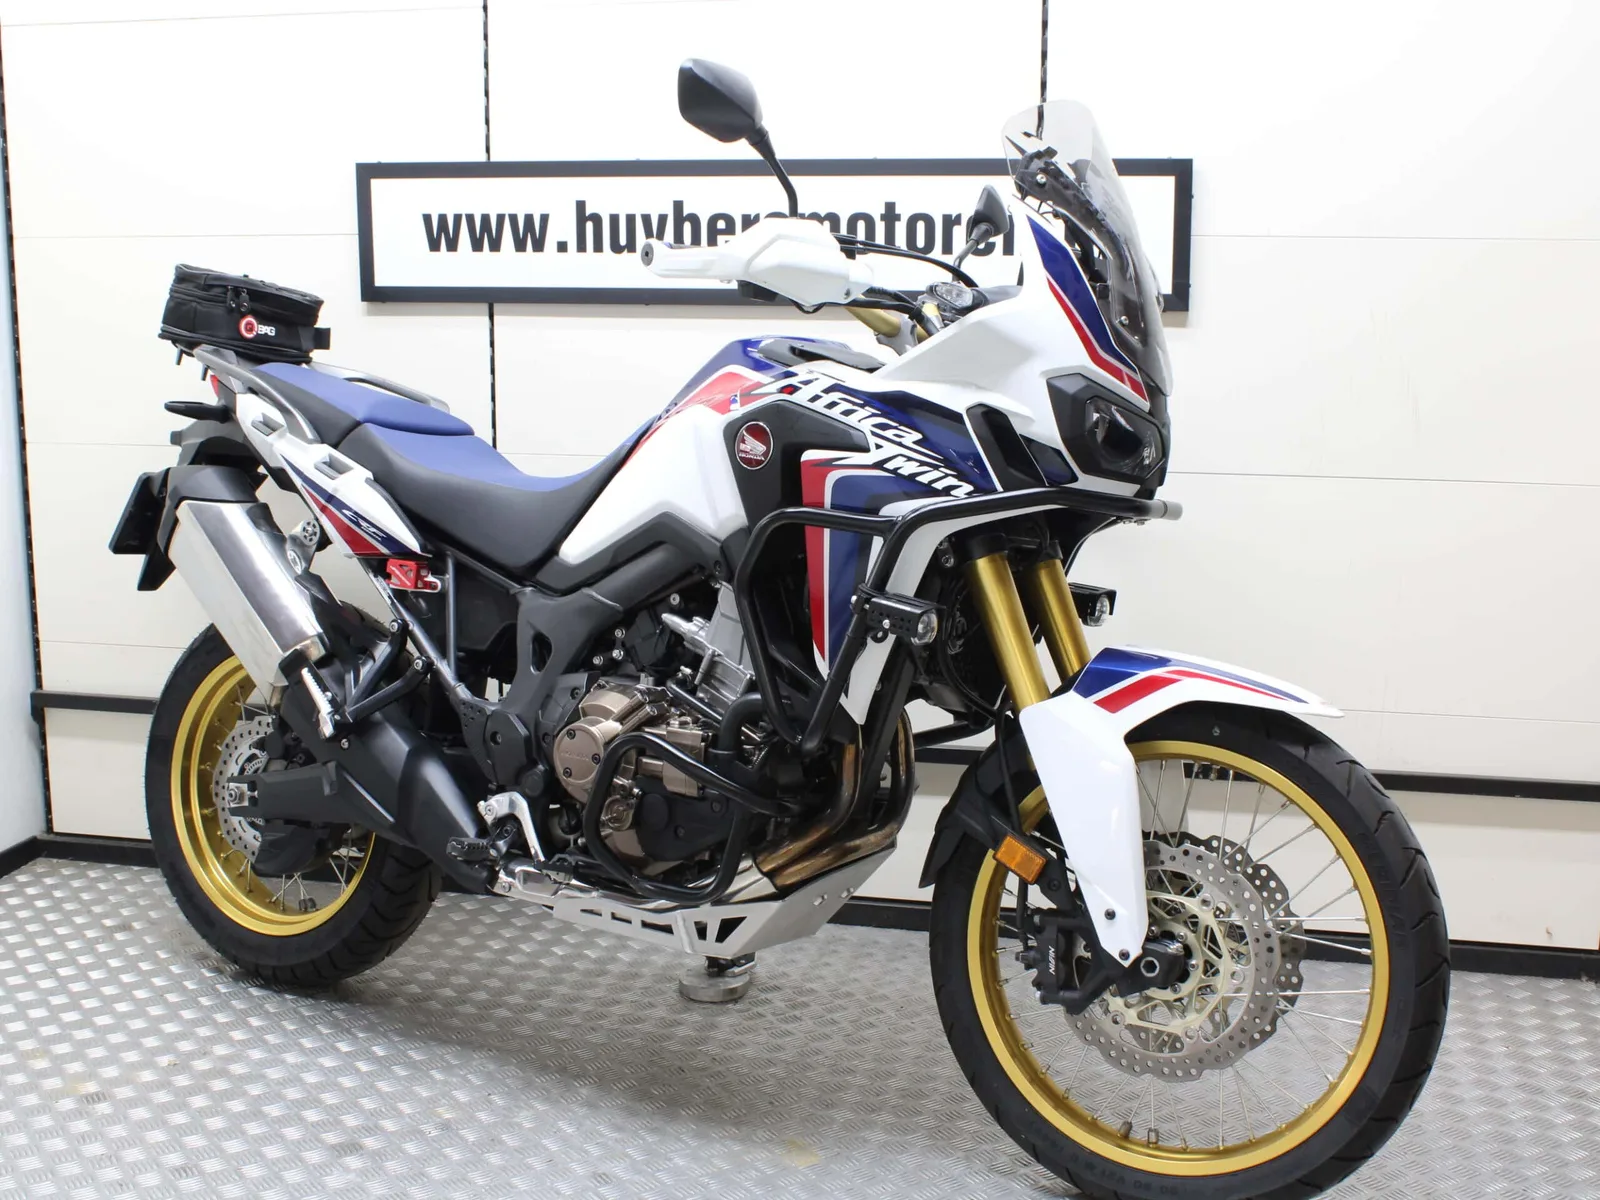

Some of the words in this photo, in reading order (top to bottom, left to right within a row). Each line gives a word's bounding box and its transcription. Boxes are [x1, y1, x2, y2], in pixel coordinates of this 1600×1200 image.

[751, 370, 945, 460] Africa
[738, 451, 766, 461] HONDA
[832, 427, 976, 499] Twin
